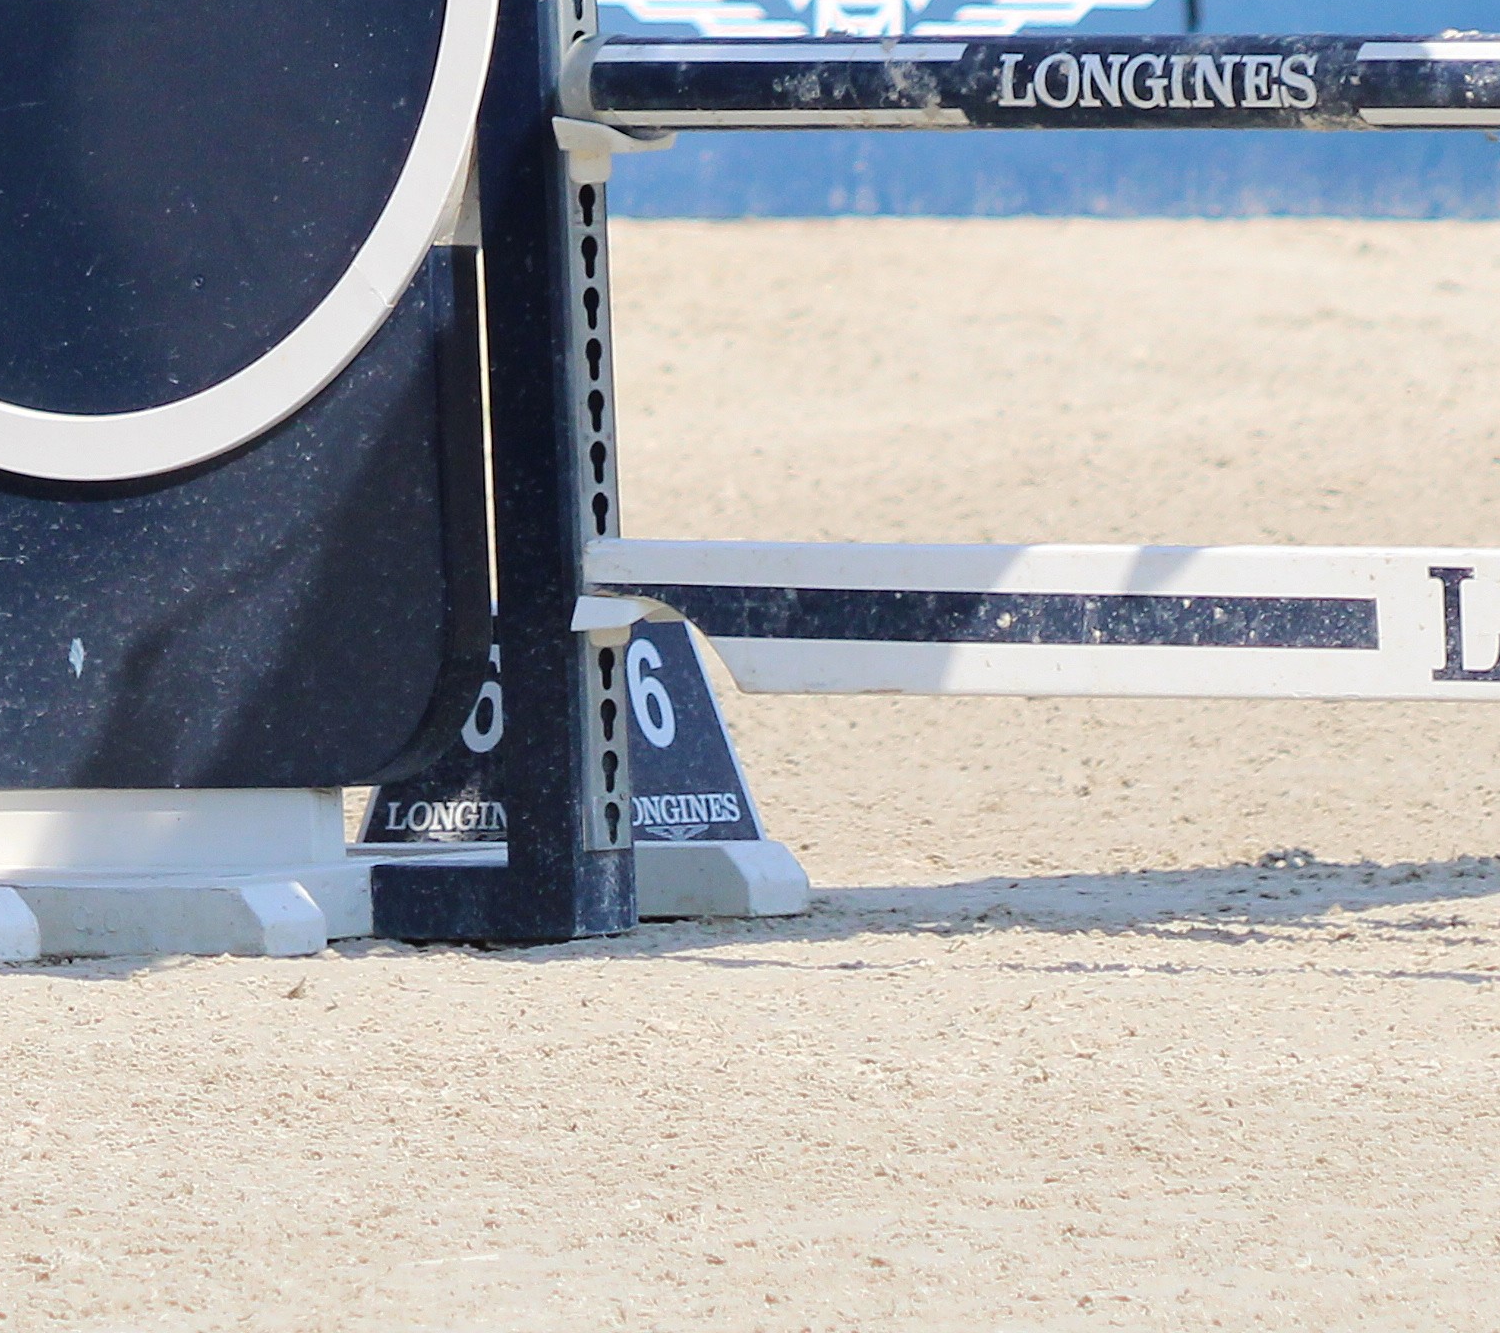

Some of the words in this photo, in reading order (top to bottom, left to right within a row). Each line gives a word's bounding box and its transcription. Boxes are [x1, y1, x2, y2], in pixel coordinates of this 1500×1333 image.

[997, 51, 1320, 110] LONGINES
[626, 638, 677, 748] 6
[384, 801, 508, 831] LONGIN
[631, 793, 741, 827] NGINES
